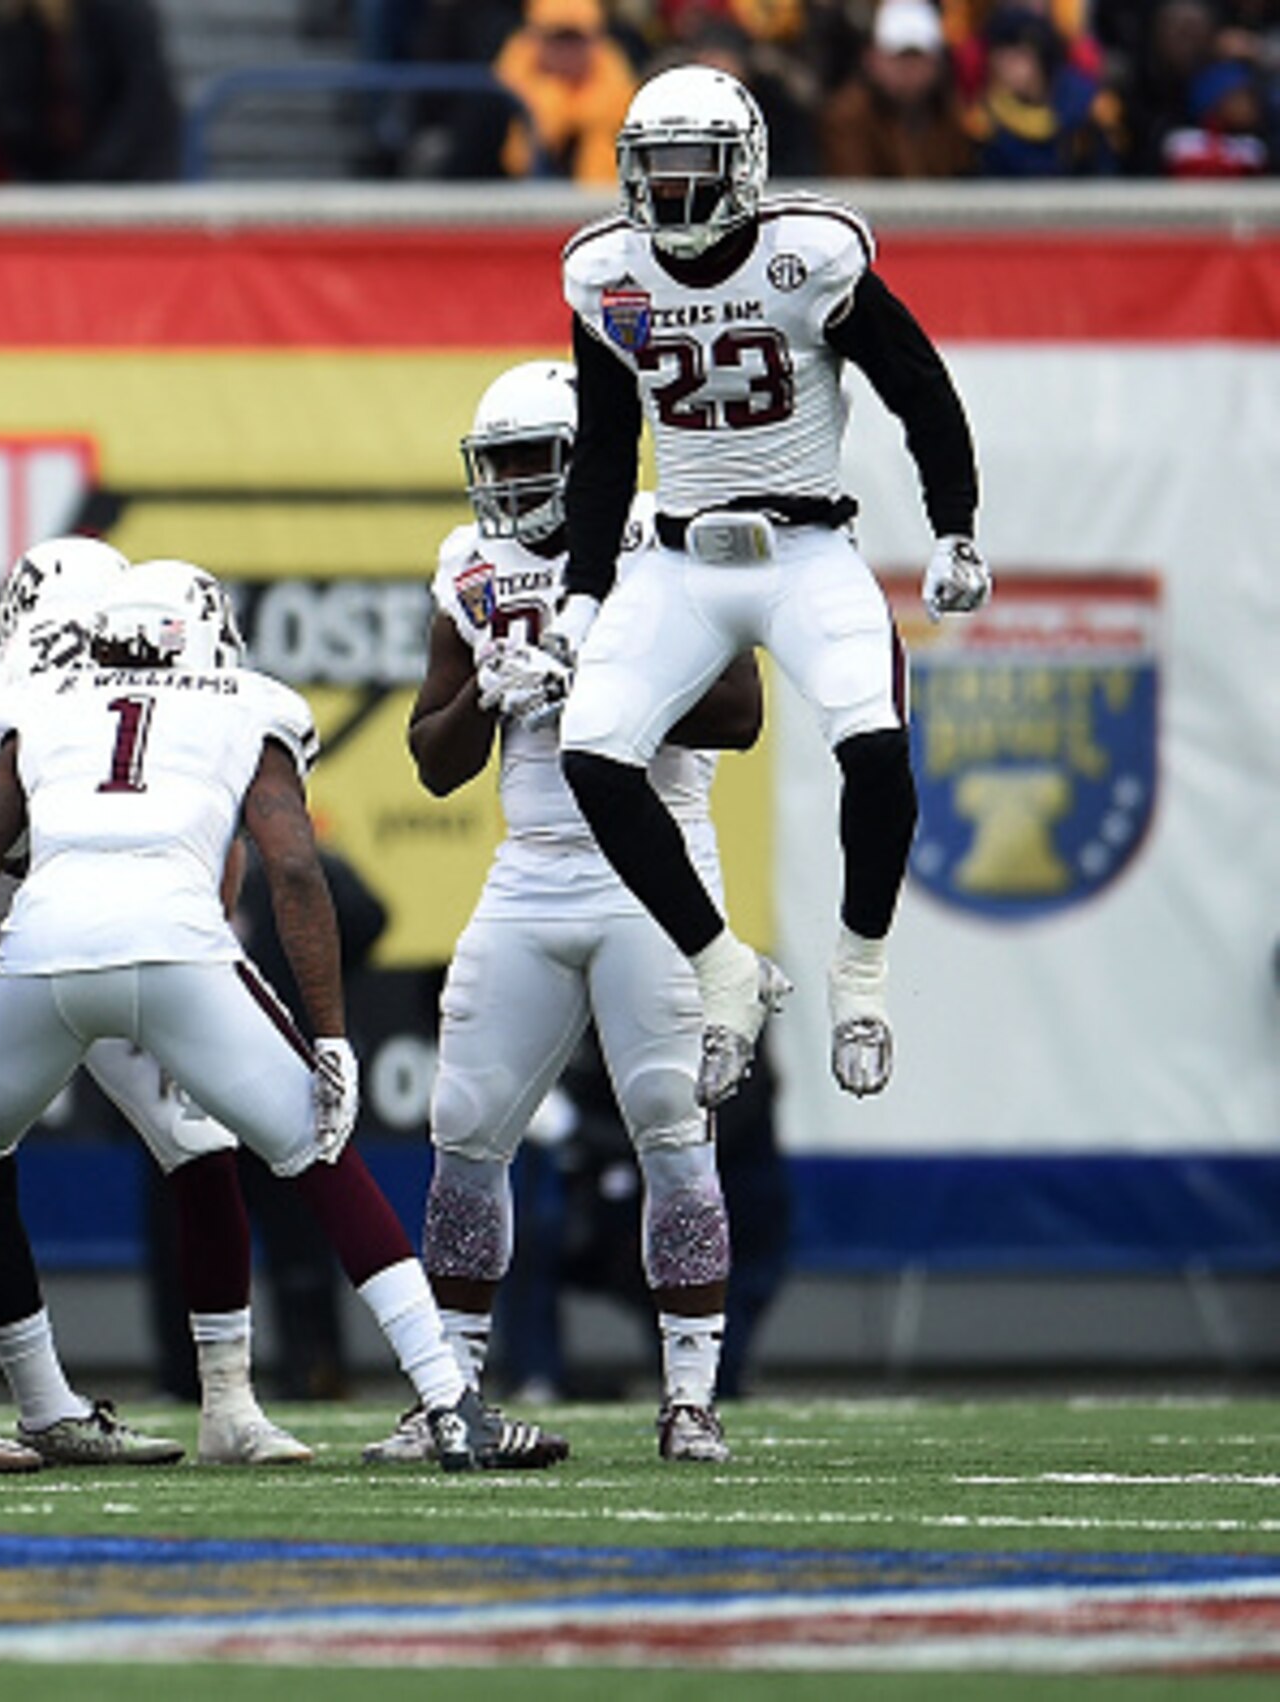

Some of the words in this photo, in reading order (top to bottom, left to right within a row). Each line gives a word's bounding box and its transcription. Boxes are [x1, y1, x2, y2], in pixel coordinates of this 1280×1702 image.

[634, 327, 796, 430] 23
[497, 570, 553, 595] TEXAS
[94, 666, 238, 694] WILLIAMS
[97, 693, 156, 792] 1
